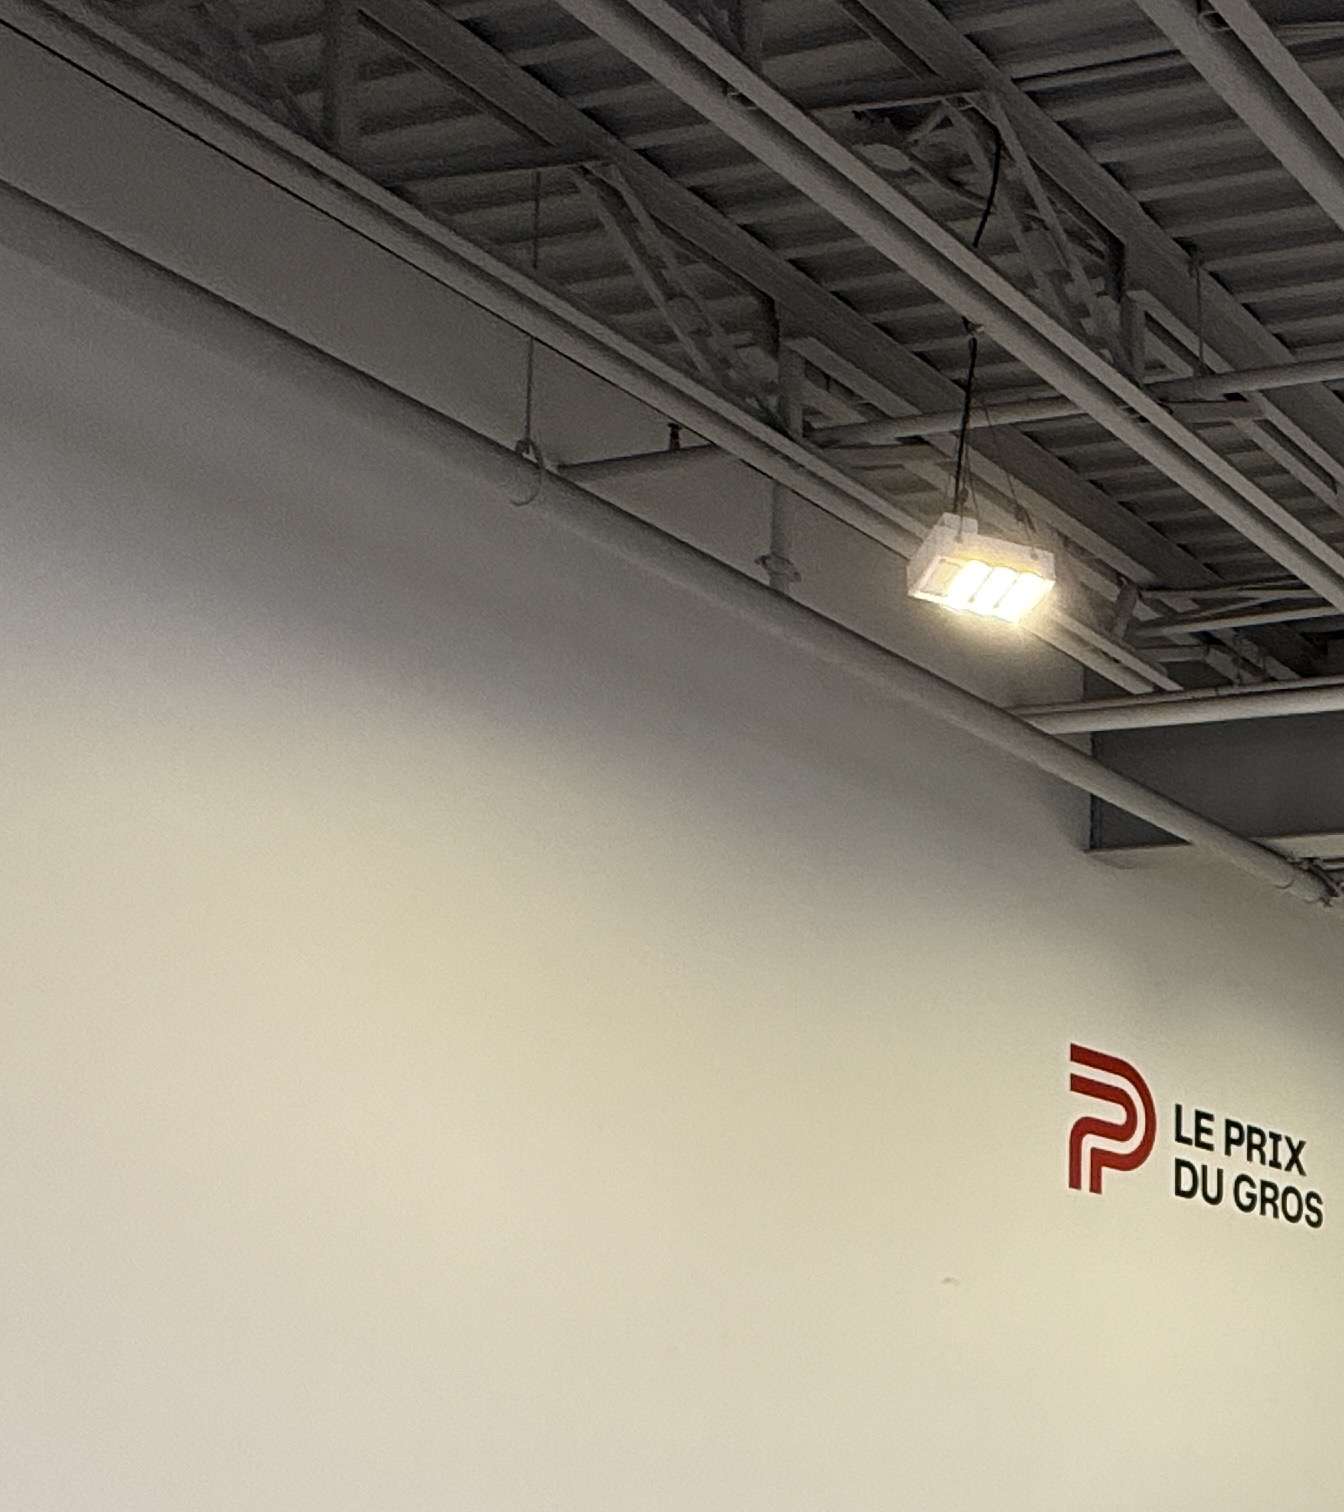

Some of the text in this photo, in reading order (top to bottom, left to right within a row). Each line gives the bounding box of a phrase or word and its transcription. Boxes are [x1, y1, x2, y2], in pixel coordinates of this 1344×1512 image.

[1174, 1103, 1307, 1177] LE PRIX
[1174, 1157, 1324, 1229] DU GROS
